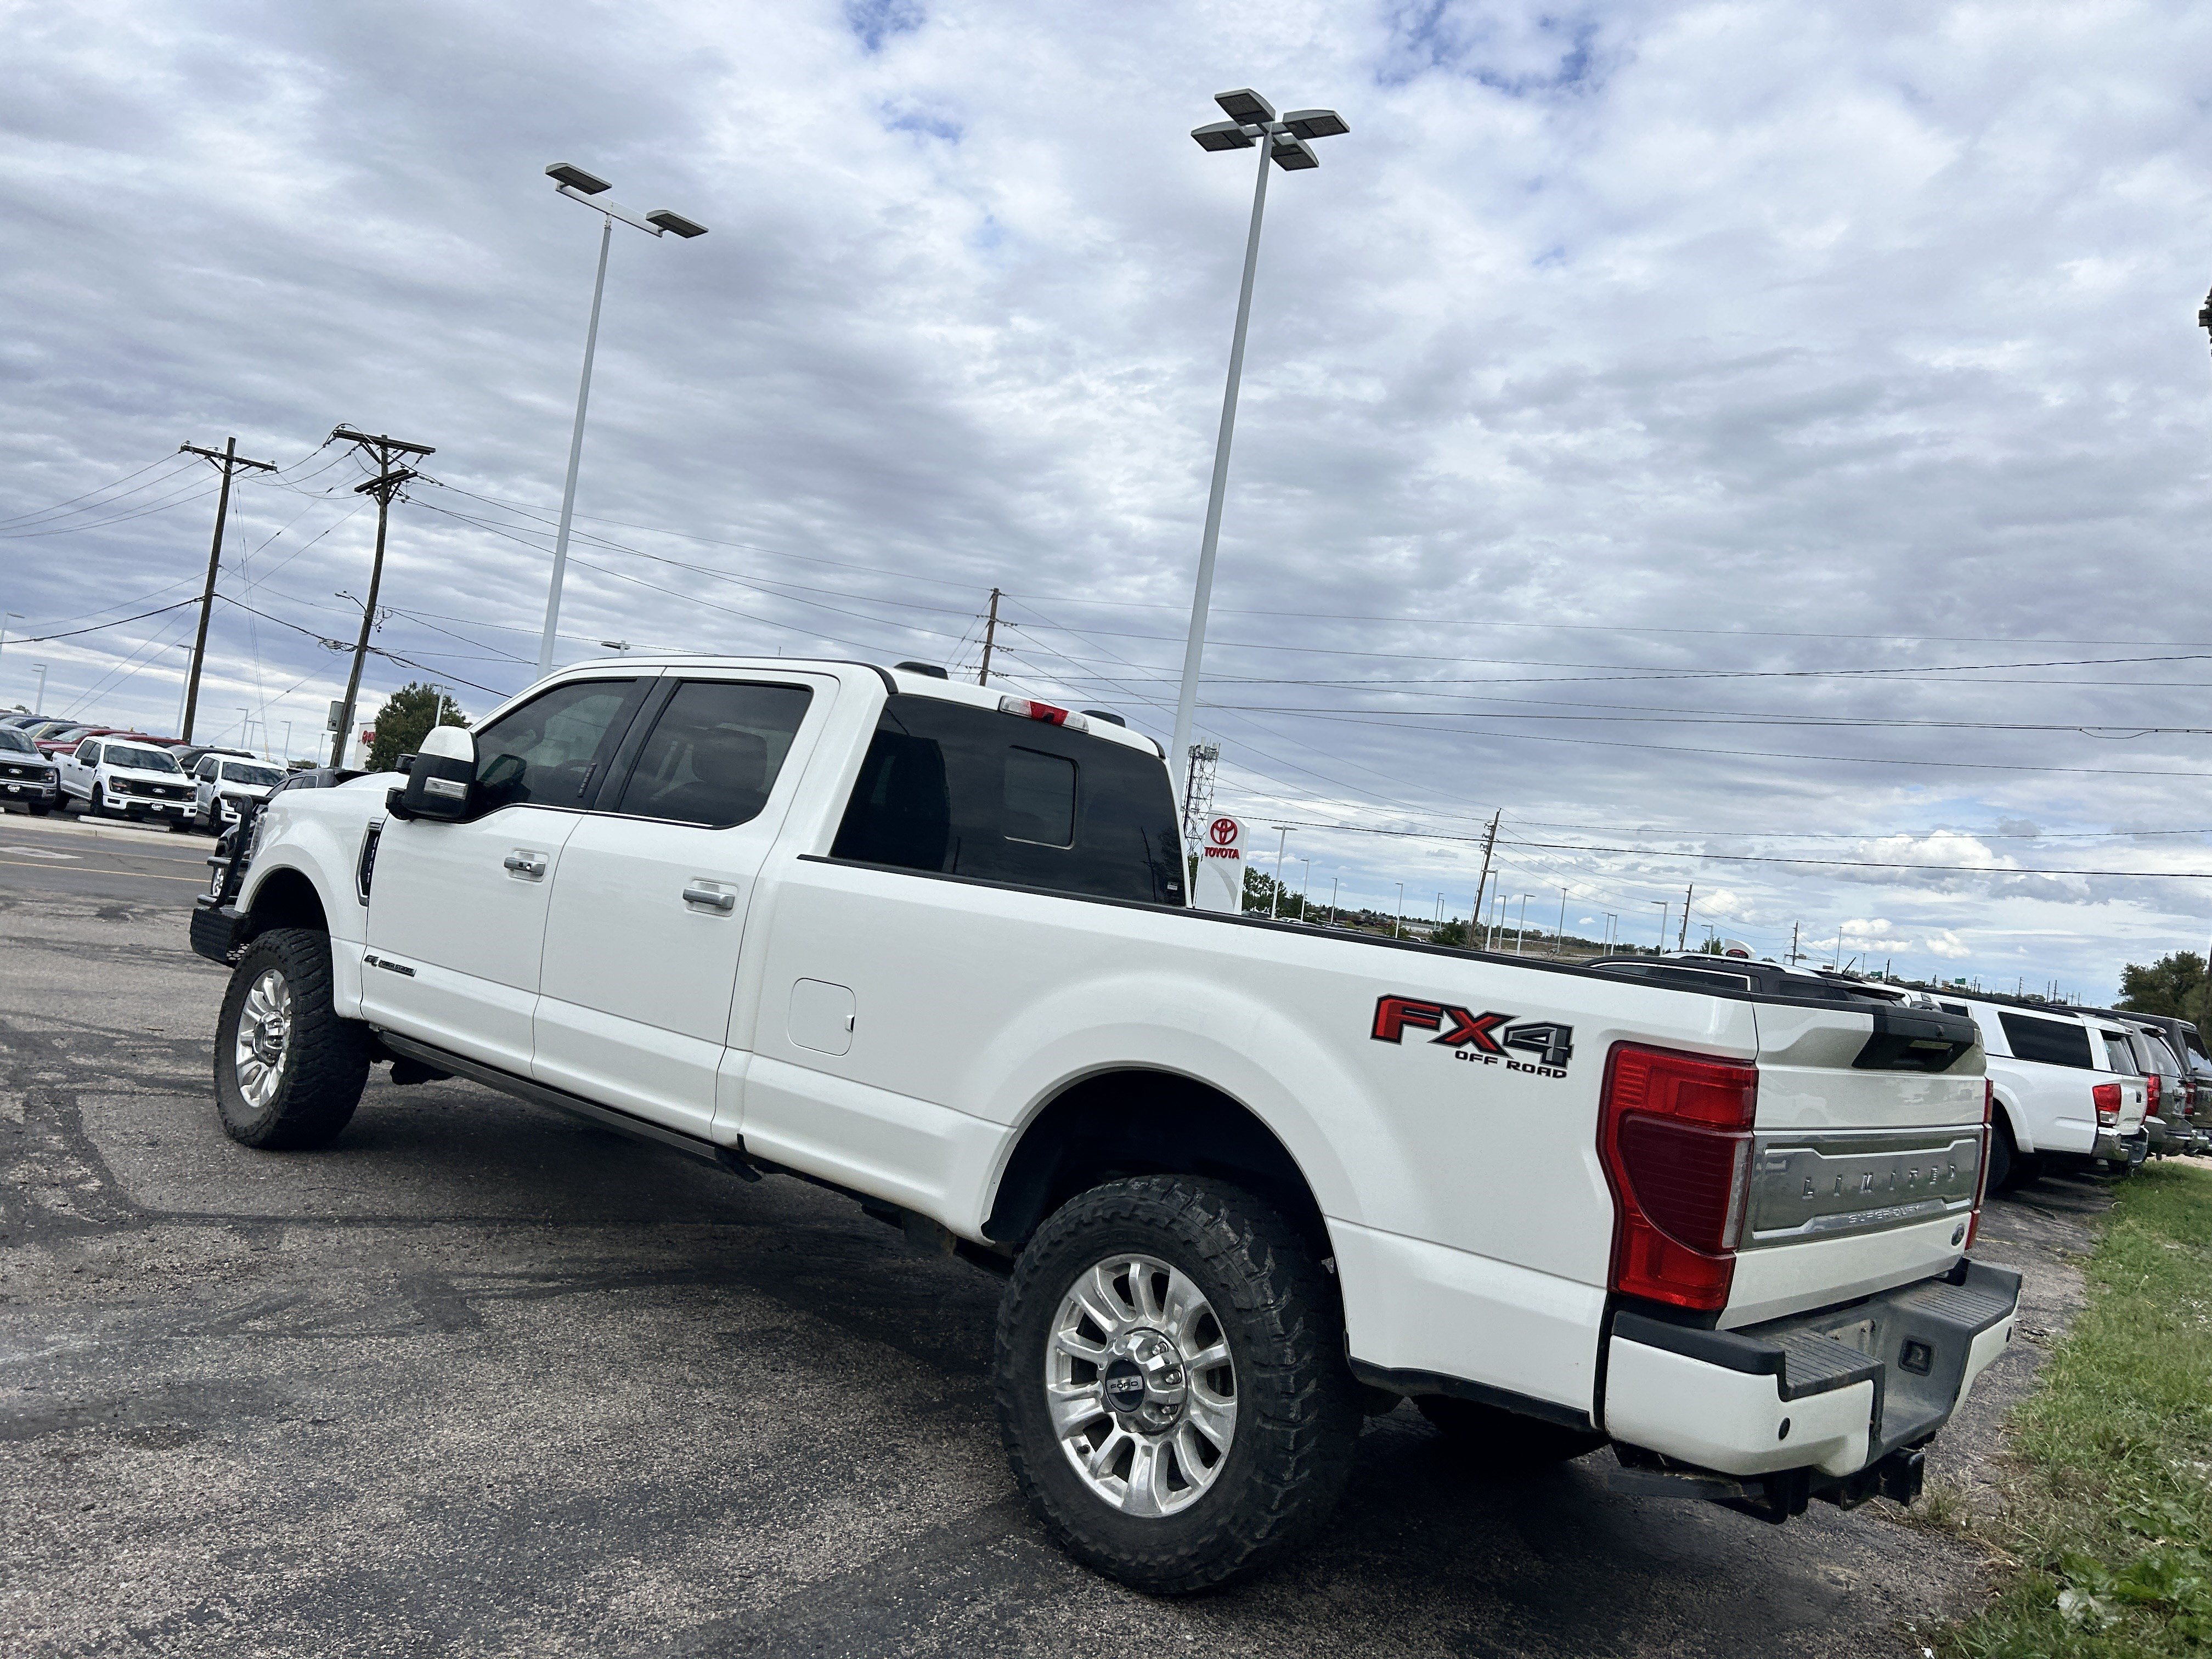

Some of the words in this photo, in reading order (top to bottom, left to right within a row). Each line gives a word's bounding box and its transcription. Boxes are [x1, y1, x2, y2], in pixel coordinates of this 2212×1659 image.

[1204, 847, 1240, 860] TOYOTA
[1370, 994, 1575, 1069] FX4
[1454, 1050, 1498, 1065] OFF
[1506, 1059, 1567, 1079] ROAD
[1802, 1163, 1957, 1199] LIMITED
[1848, 1209, 1892, 1224] SUPER
[1110, 1381, 1138, 1389] FORD
